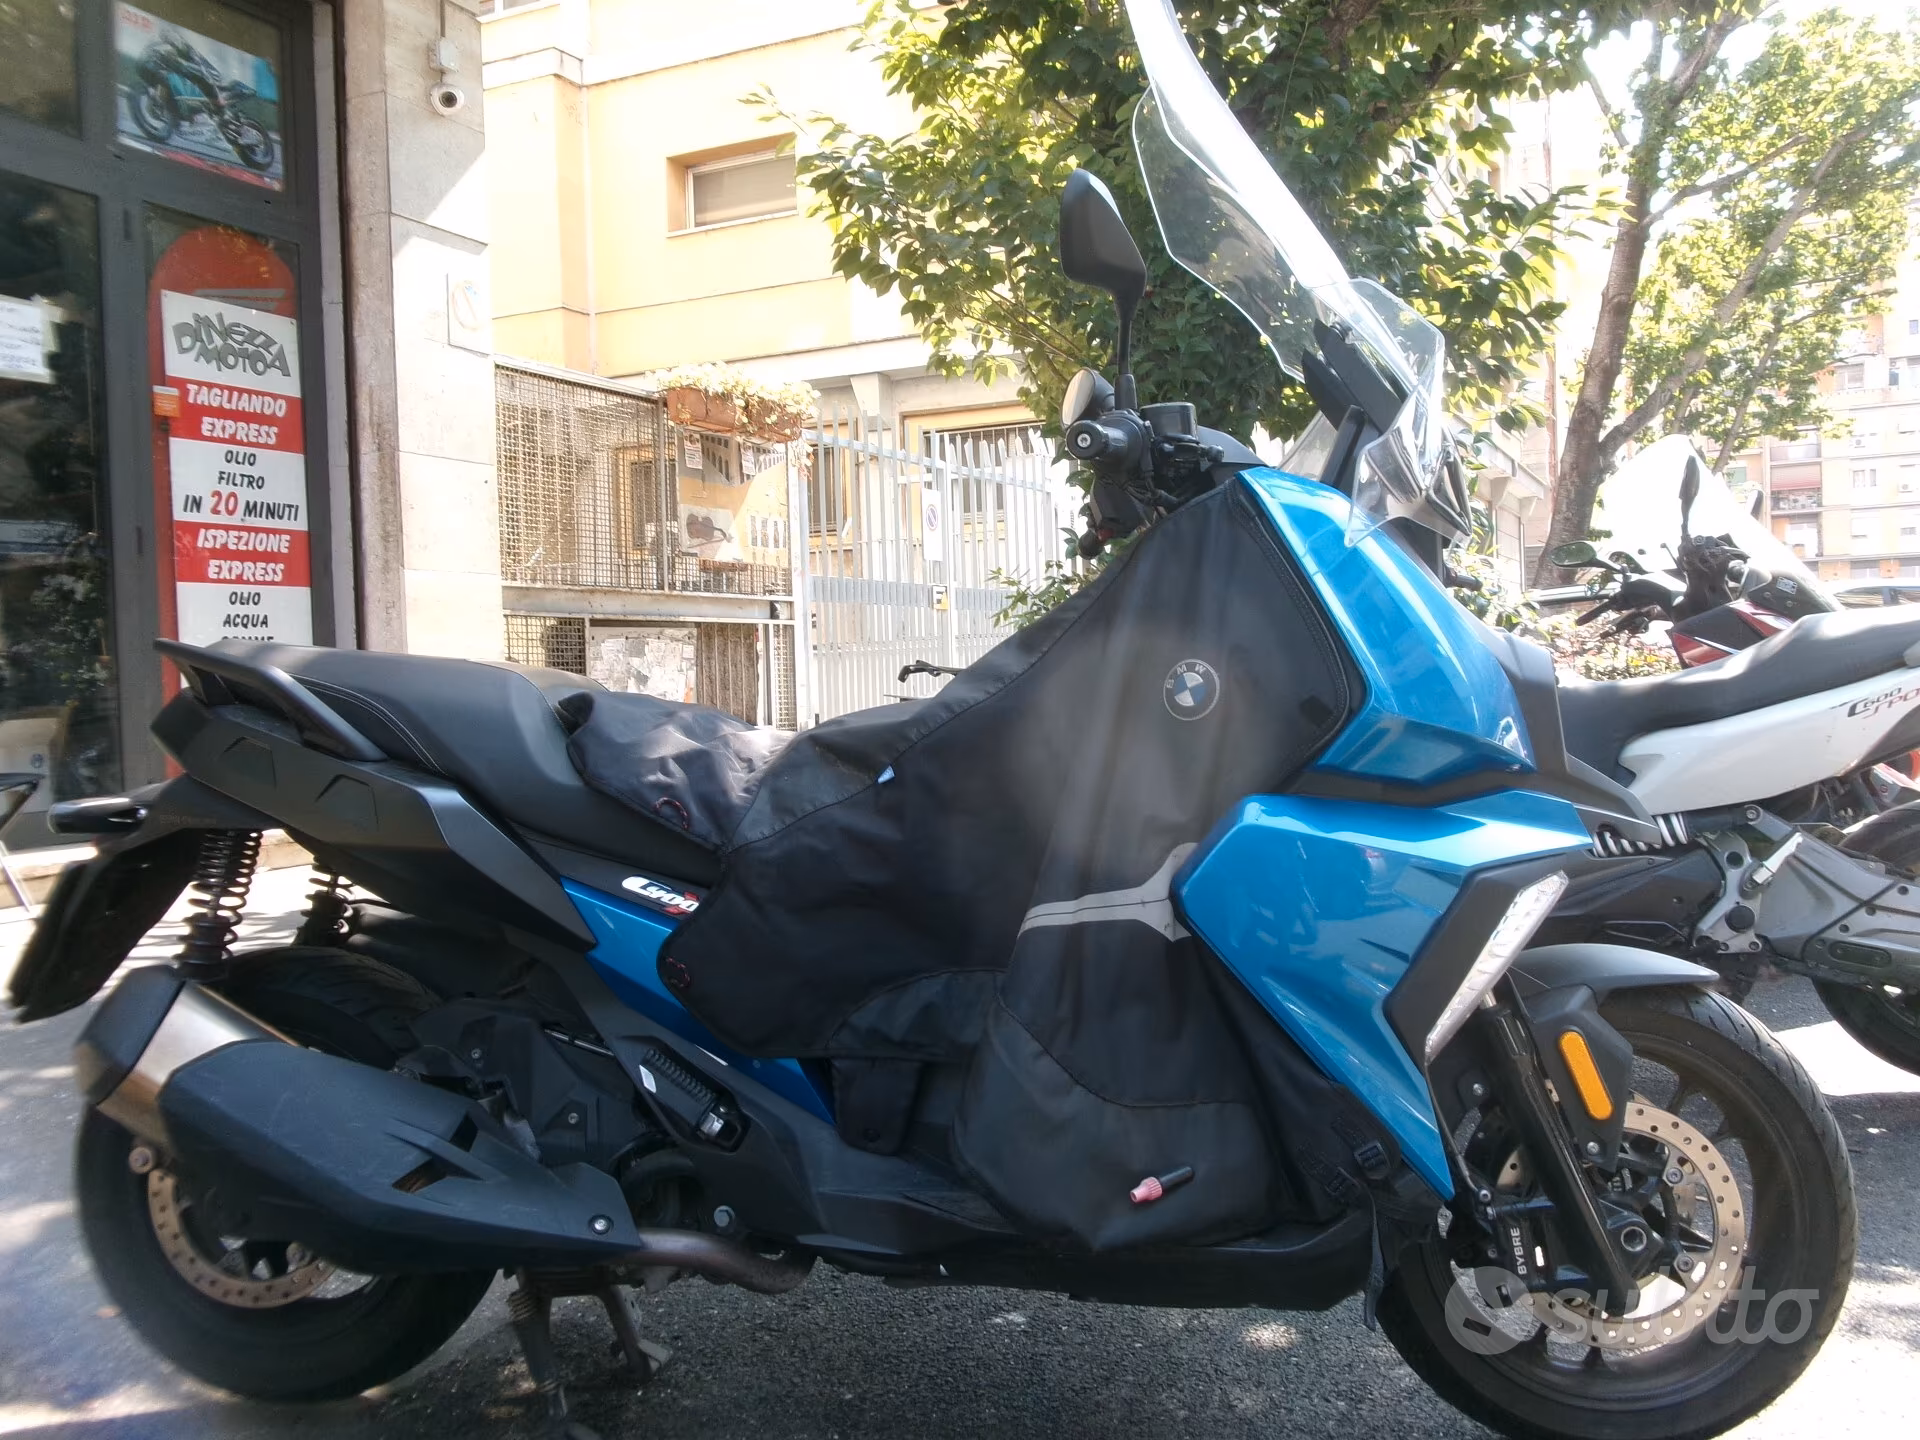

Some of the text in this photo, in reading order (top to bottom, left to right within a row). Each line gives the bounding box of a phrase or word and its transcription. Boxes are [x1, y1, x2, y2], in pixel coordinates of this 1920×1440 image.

[194, 342, 268, 376] MOTO
[186, 383, 287, 418] TAGLIANDO
[201, 416, 278, 445] EXPRESS
[224, 450, 257, 467] OLIO
[218, 471, 265, 490] FILTRO
[183, 490, 300, 522] IN 20 MINUTI
[197, 528, 291, 554] ISPEZIONE
[207, 559, 285, 582] EXPRESS
[229, 591, 261, 606] OLIO
[222, 613, 269, 629] ACQUA
[1510, 1227, 1528, 1275] BYBRE
